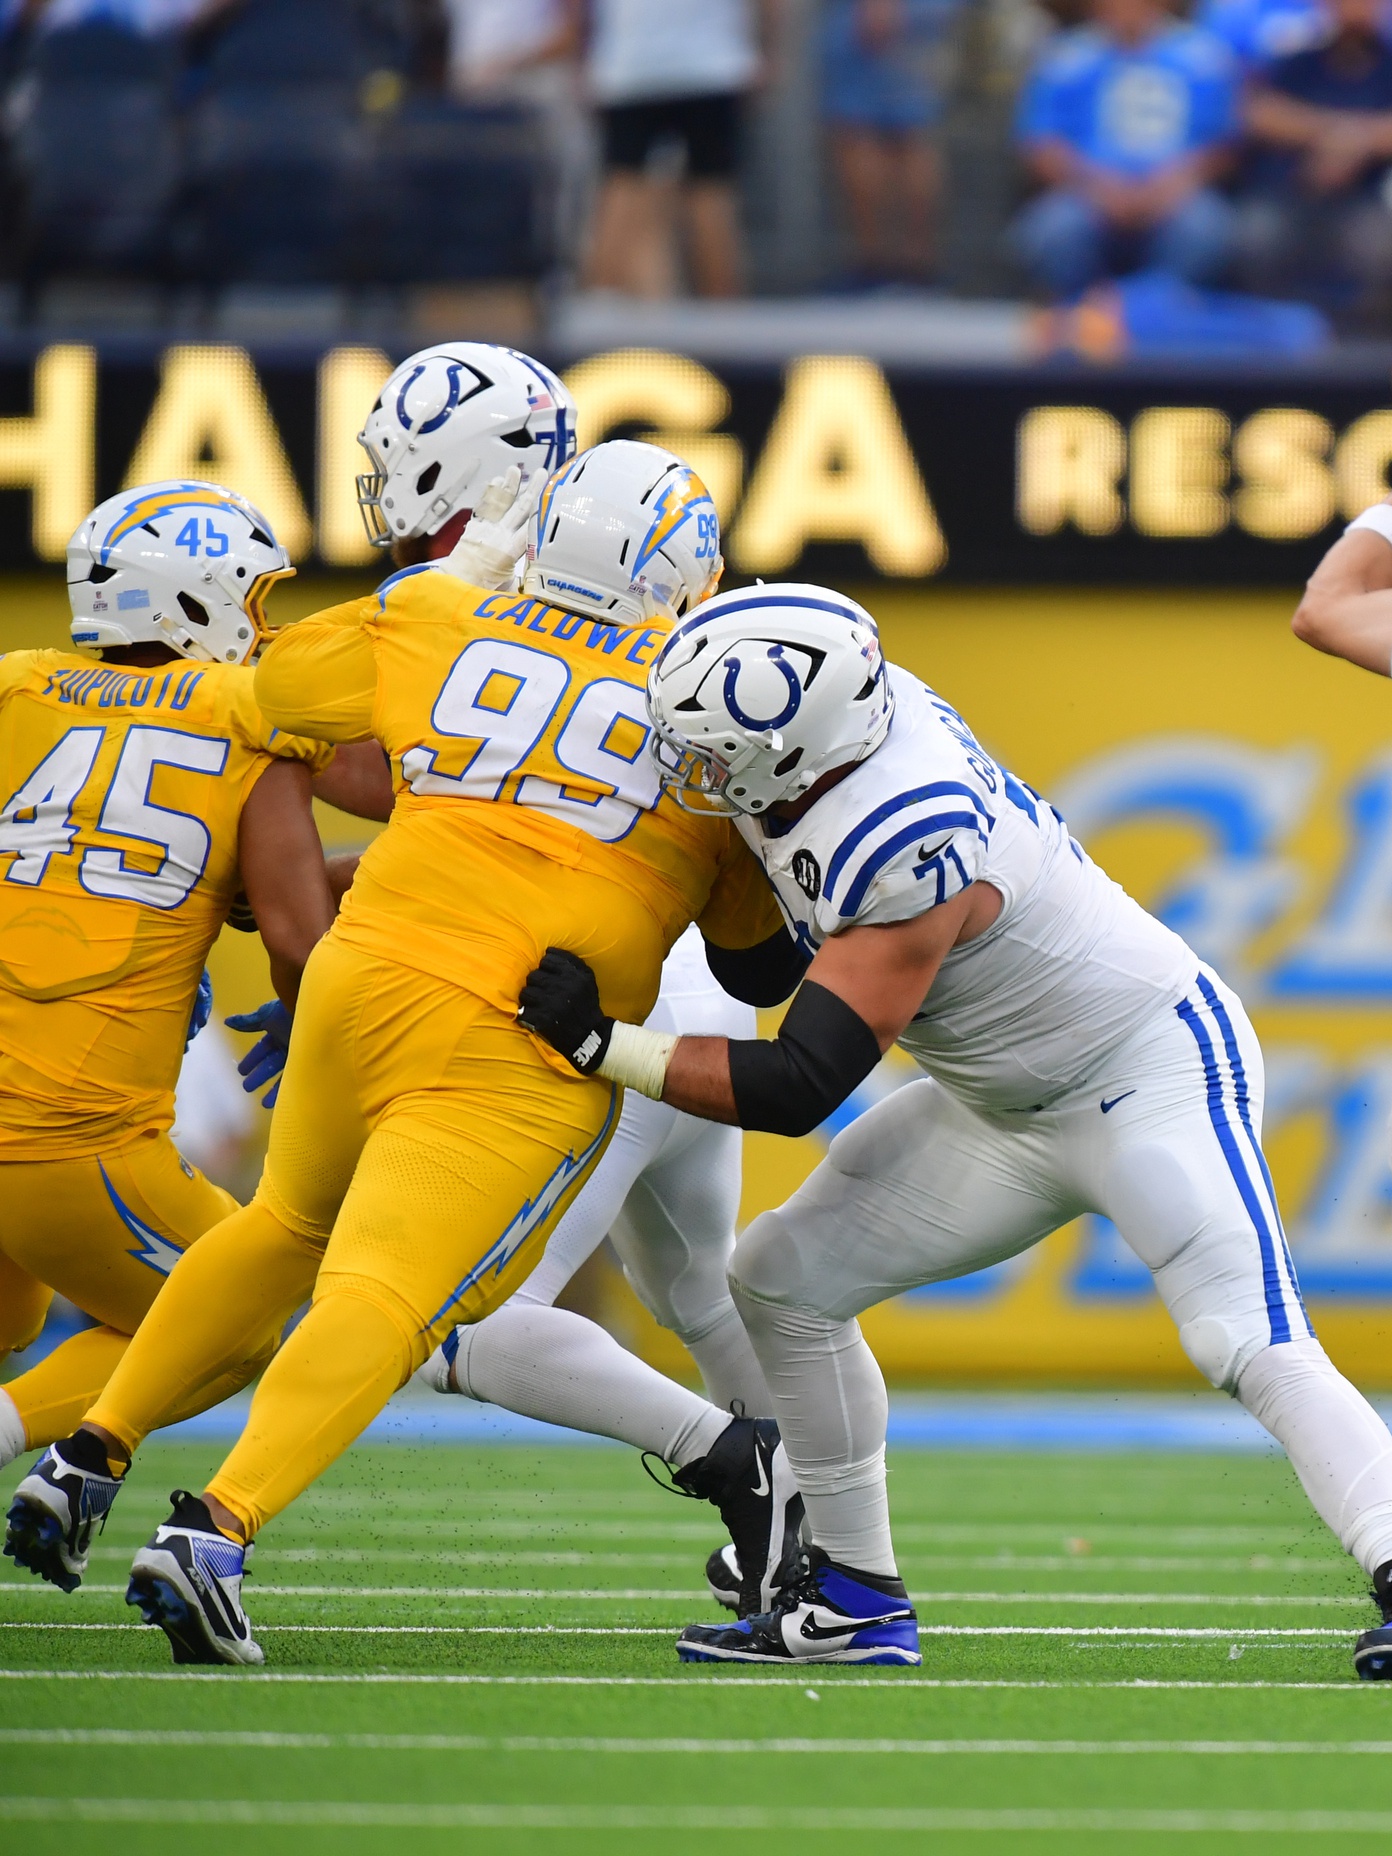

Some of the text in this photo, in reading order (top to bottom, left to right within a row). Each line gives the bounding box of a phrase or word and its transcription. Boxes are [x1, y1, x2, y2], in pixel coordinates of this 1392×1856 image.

[175, 518, 228, 557] 45
[695, 514, 719, 559] 99
[547, 578, 604, 602] CHARGERS
[473, 593, 668, 668] CALDWE
[401, 637, 686, 843] 99
[0, 724, 231, 910] 45
[912, 843, 973, 906] 71
[572, 1029, 602, 1067] NIKE
